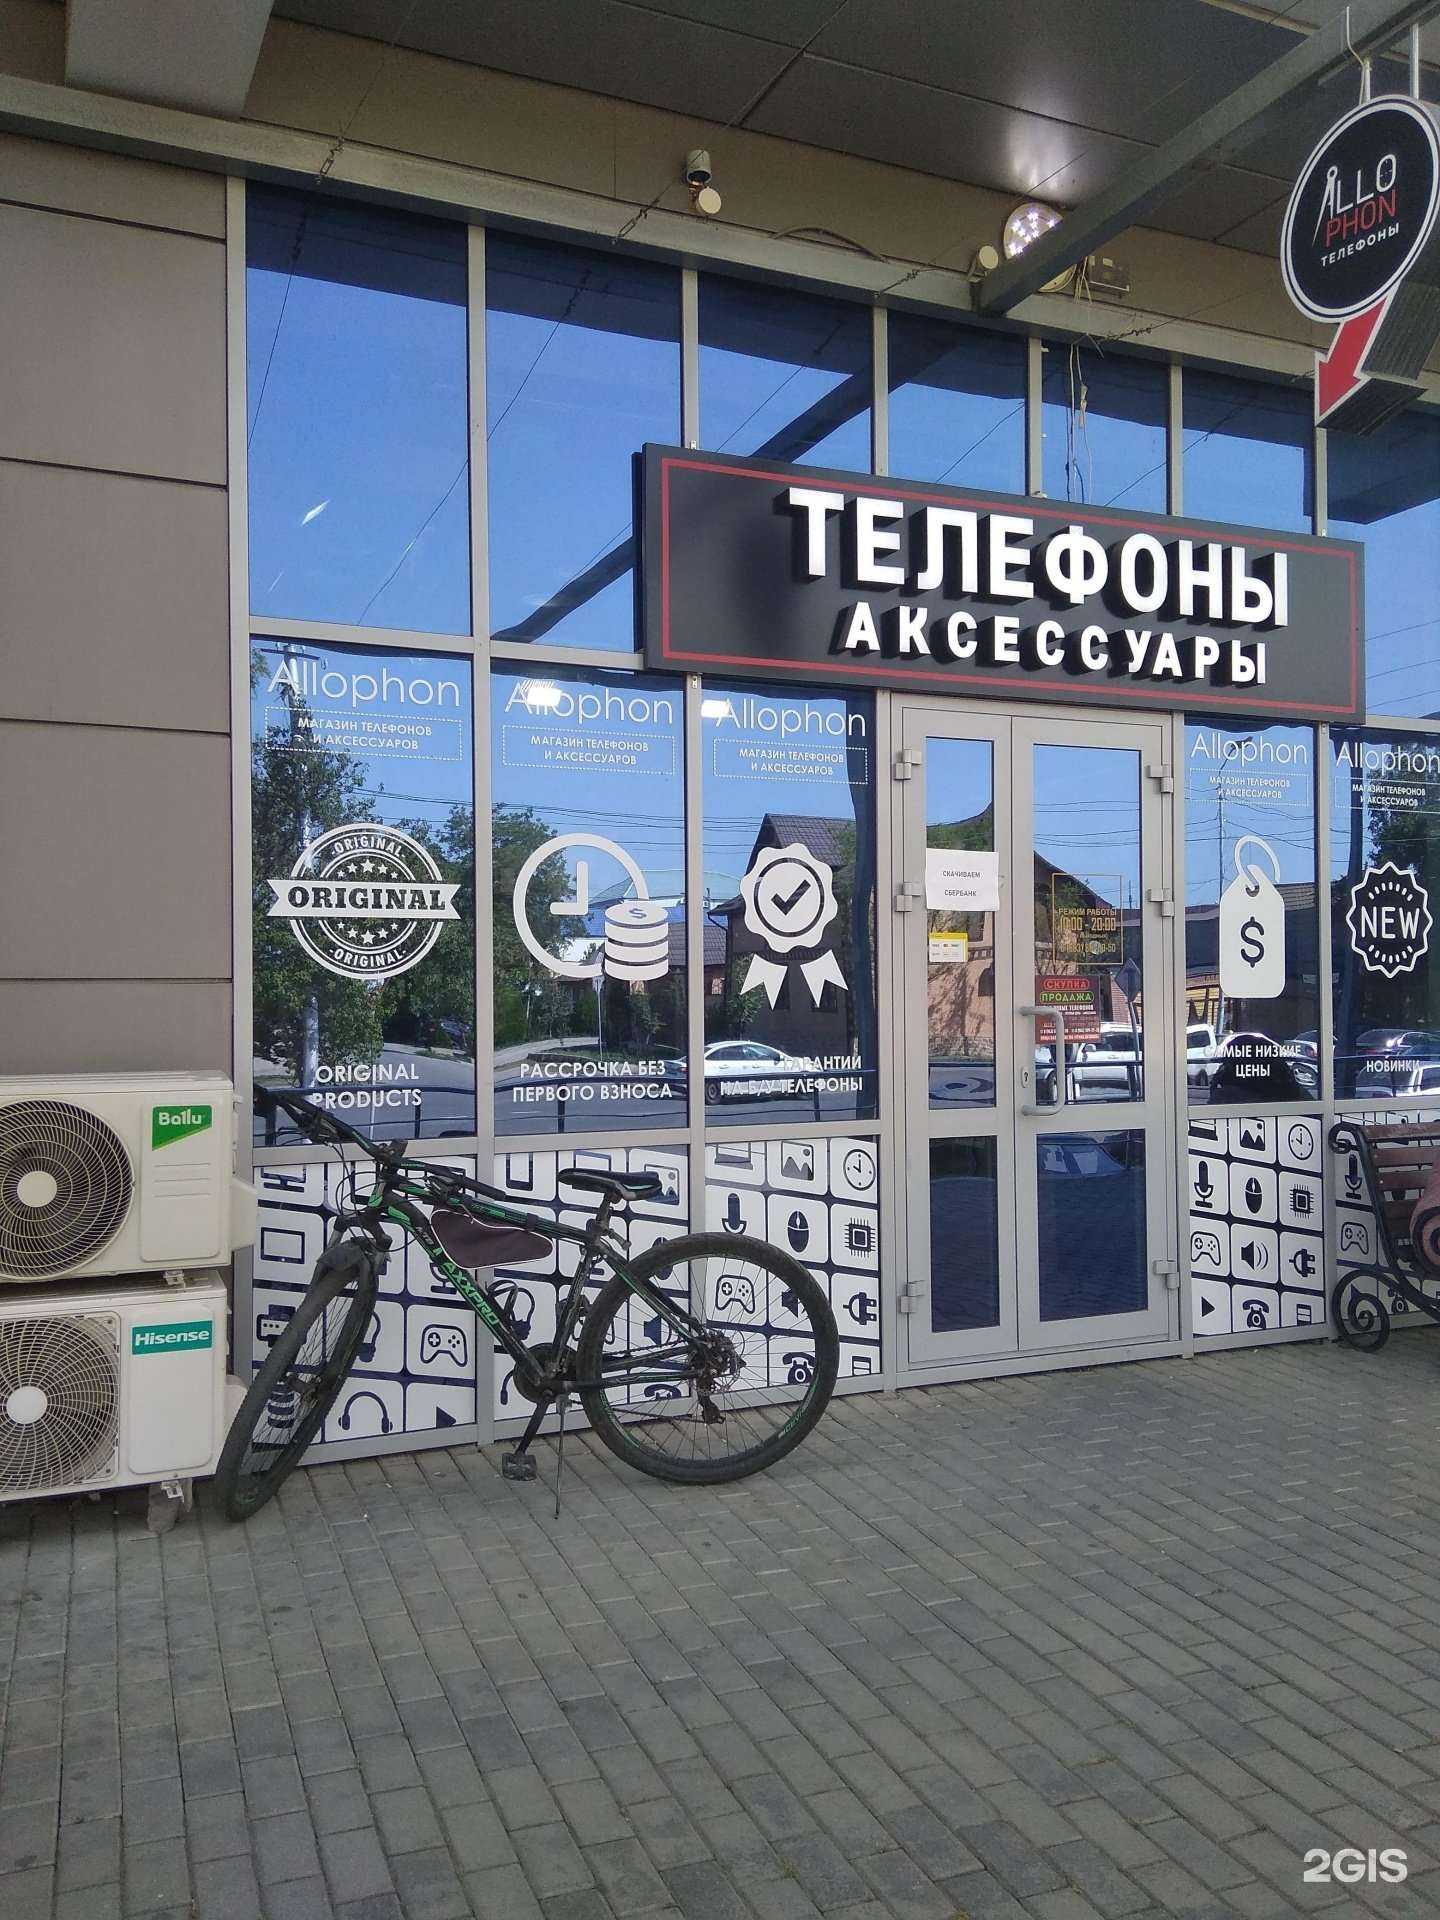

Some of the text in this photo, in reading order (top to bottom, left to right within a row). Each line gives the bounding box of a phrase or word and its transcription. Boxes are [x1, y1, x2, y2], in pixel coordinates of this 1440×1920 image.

[1312, 154, 1397, 247] ALLO
[1325, 188, 1397, 248] PHON
[1321, 222, 1400, 267] ТЕЛЕФОНЫ
[788, 486, 1290, 628] ТЕЛЕФОНЫ
[843, 601, 1267, 685] АКСЕССУАРЫ
[267, 658, 460, 708] Allophon
[297, 716, 433, 737] МАГАЗИН ТЕЛЕФОНОВ
[715, 697, 866, 739] Allophon
[313, 735, 419, 751] И АКСЕССУАРОВ
[530, 734, 650, 753] МАГАЗИН ТЕЛЕФОНОВ
[1190, 732, 1308, 768] Allophon
[543, 750, 637, 766] И АКСЕССУАРОВ
[739, 747, 845, 764] МАГАЗИН ТЕЛЕФОНОВ
[1335, 740, 1440, 777] Allophon
[751, 762, 834, 776] И АКСЕССУАРОВ
[1209, 775, 1290, 789] МАГАЗИН ТЕЛЕФОНОВ
[1352, 783, 1426, 797] МАГАЗИН ТЕЛЕФОНОВ
[1226, 788, 1282, 800] АКСЕССУАРОВ
[1367, 795, 1419, 808] АКСЕССУАРОВ
[287, 886, 446, 911] ORIGINAL
[944, 889, 978, 898] СБЕРБАНК
[1087, 908, 1117, 917] РАБОТЫ
[1360, 906, 1421, 939] NEW
[1041, 992, 1092, 1002] ПРОДАЖА
[1256, 1044, 1302, 1058] НИЗКИЕ
[315, 1063, 420, 1083] ORIGINAL
[520, 1059, 666, 1079] РАССРОЧКА БЕЗ
[1235, 1063, 1271, 1078] ЦЕНЫ
[1366, 1059, 1420, 1073] НОВИНКИ
[513, 1082, 673, 1102] ПЕРВОГО ВЗНОСА
[779, 1077, 863, 1094] ТЕЛЕФОНЫ
[312, 1088, 422, 1110] PRODUCTS
[158, 1109, 202, 1126] Ballu
[135, 1327, 211, 1347] Hisense
